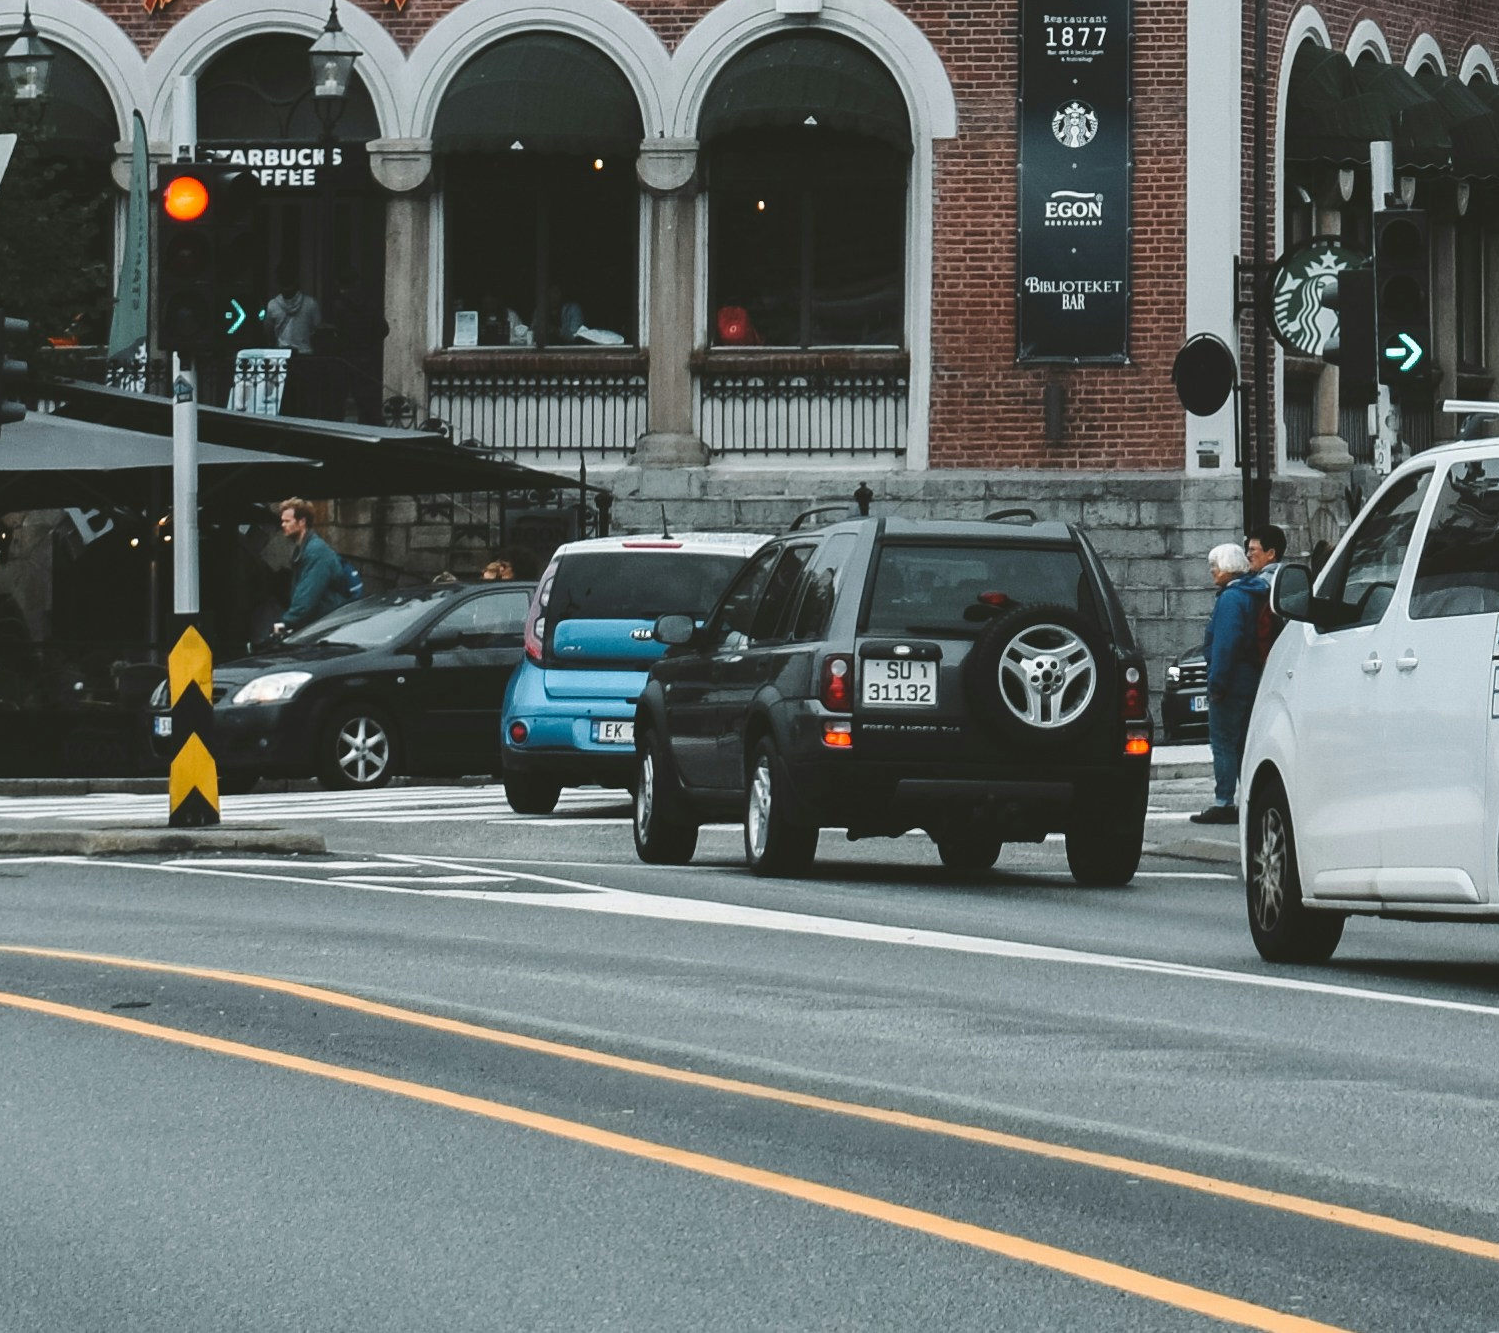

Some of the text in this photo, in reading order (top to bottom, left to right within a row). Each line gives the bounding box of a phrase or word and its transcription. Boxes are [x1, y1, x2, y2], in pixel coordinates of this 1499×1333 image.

[1043, 15, 1109, 24] Restaurant
[1045, 26, 1108, 48] 1877
[251, 168, 316, 187] FFEE
[1044, 201, 1102, 218] EGON
[1061, 293, 1085, 310] BAR
[632, 629, 652, 639] KIA
[887, 661, 912, 680] SU
[868, 683, 931, 703] 31132
[604, 723, 623, 738] EK
